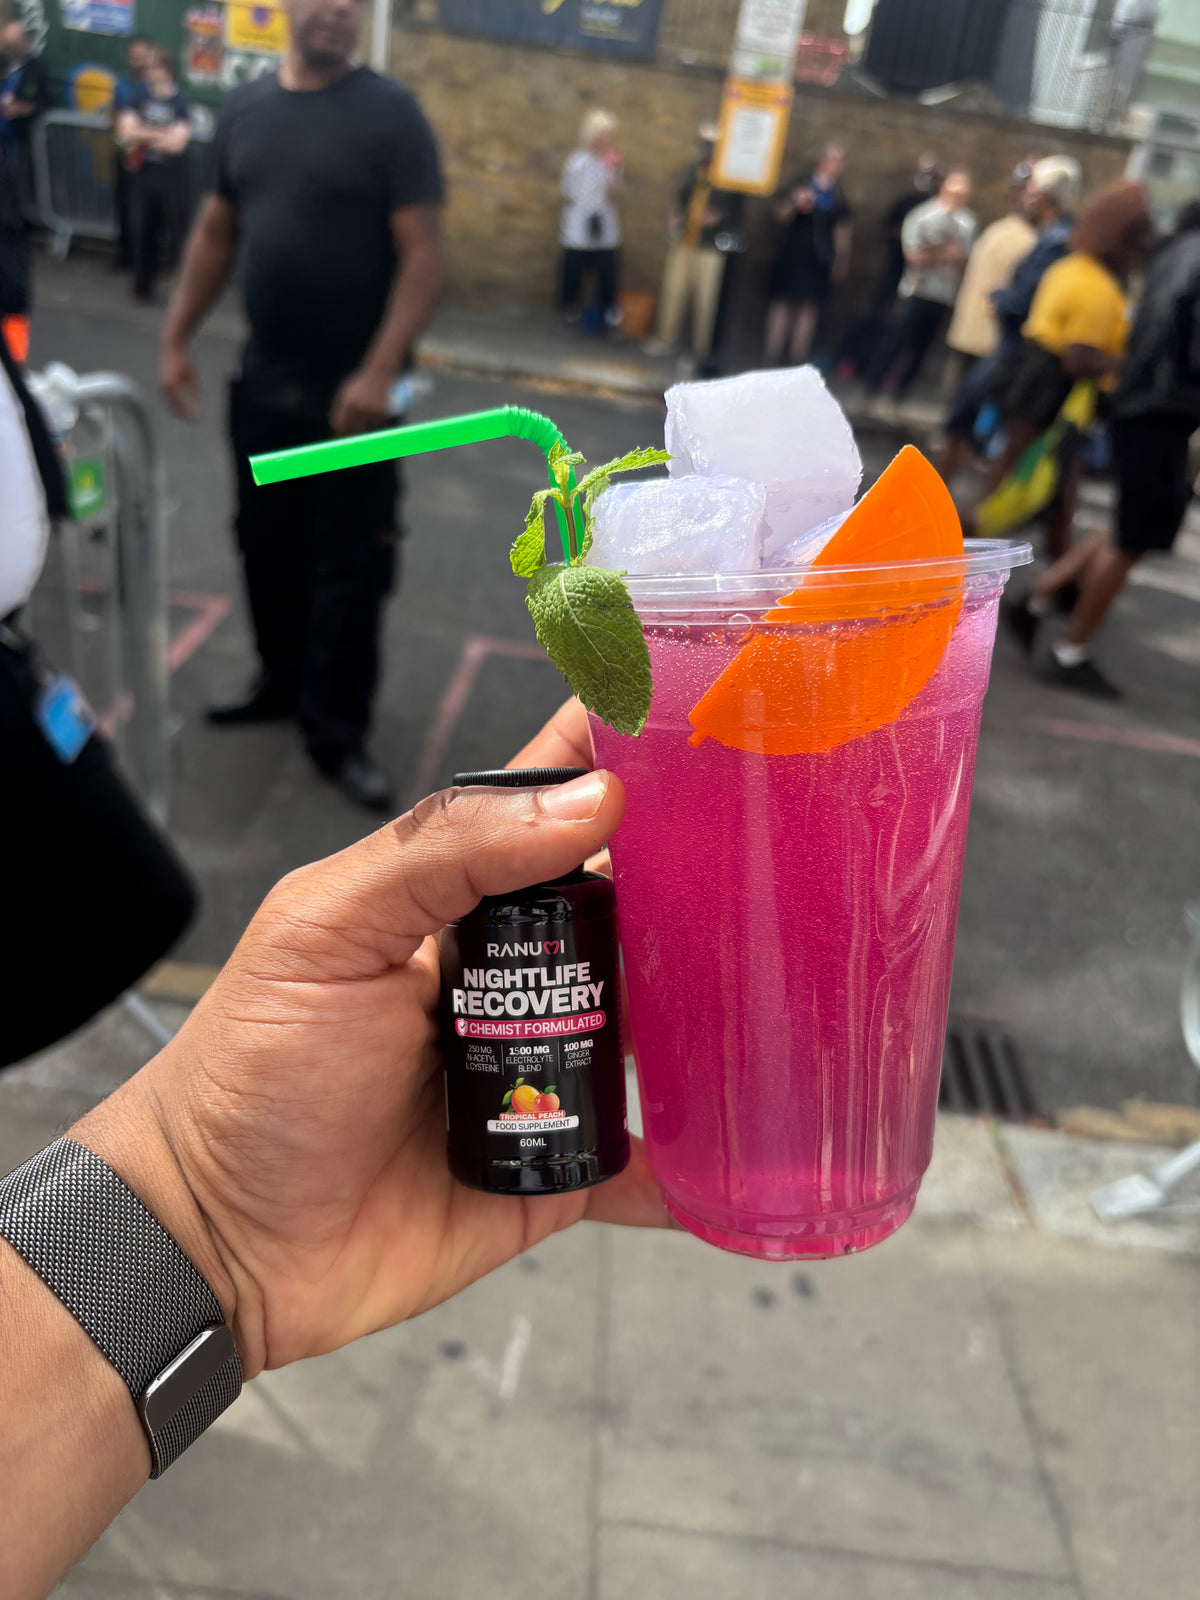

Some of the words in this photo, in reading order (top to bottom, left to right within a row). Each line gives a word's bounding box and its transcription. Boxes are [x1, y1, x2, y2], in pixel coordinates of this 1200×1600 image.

[463, 962, 591, 988] NIGHTLIFE
[453, 982, 604, 1016] RECOVERY
[470, 1023, 522, 1035] CHEMIST
[524, 1014, 602, 1034] FORMULATED
[468, 1045, 479, 1053] 250
[510, 1046, 532, 1055] 1500
[534, 1045, 550, 1054] MG
[564, 1042, 579, 1051] 100
[580, 1039, 594, 1048] MG
[567, 1049, 590, 1059] GINGER
[506, 1055, 553, 1064] ELECTROLYTE
[565, 1057, 592, 1068] EXTRACT
[518, 1064, 541, 1072] BLEND
[538, 1111, 564, 1119] PEACH
[518, 1120, 570, 1130] SUPPLEMENT
[520, 1138, 547, 1146] 60ML
